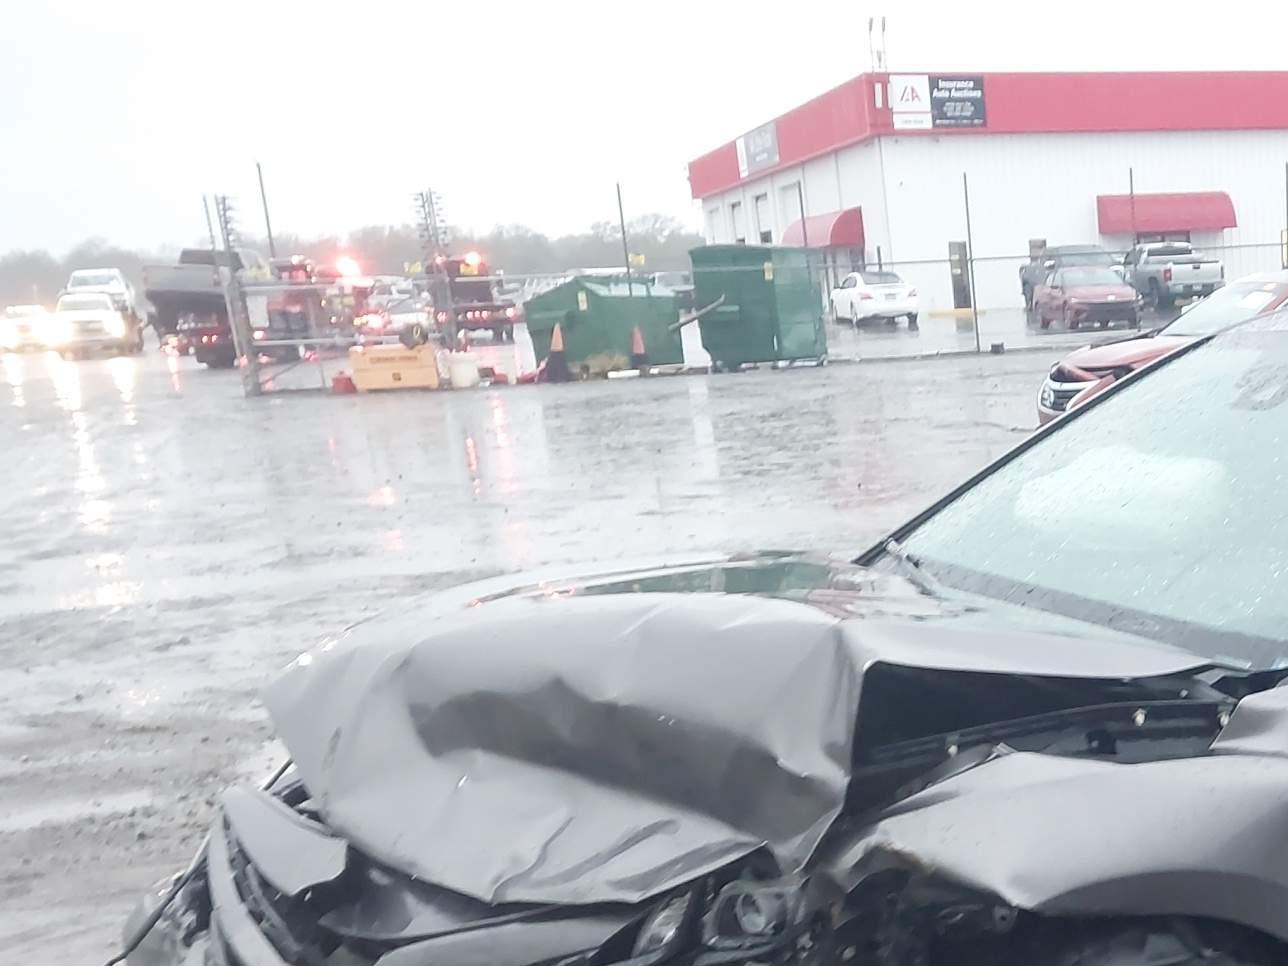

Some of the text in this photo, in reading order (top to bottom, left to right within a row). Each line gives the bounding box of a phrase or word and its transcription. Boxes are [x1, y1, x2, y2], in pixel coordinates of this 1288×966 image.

[938, 79, 974, 89] Insurance
[932, 87, 982, 98] Auto Auctions
